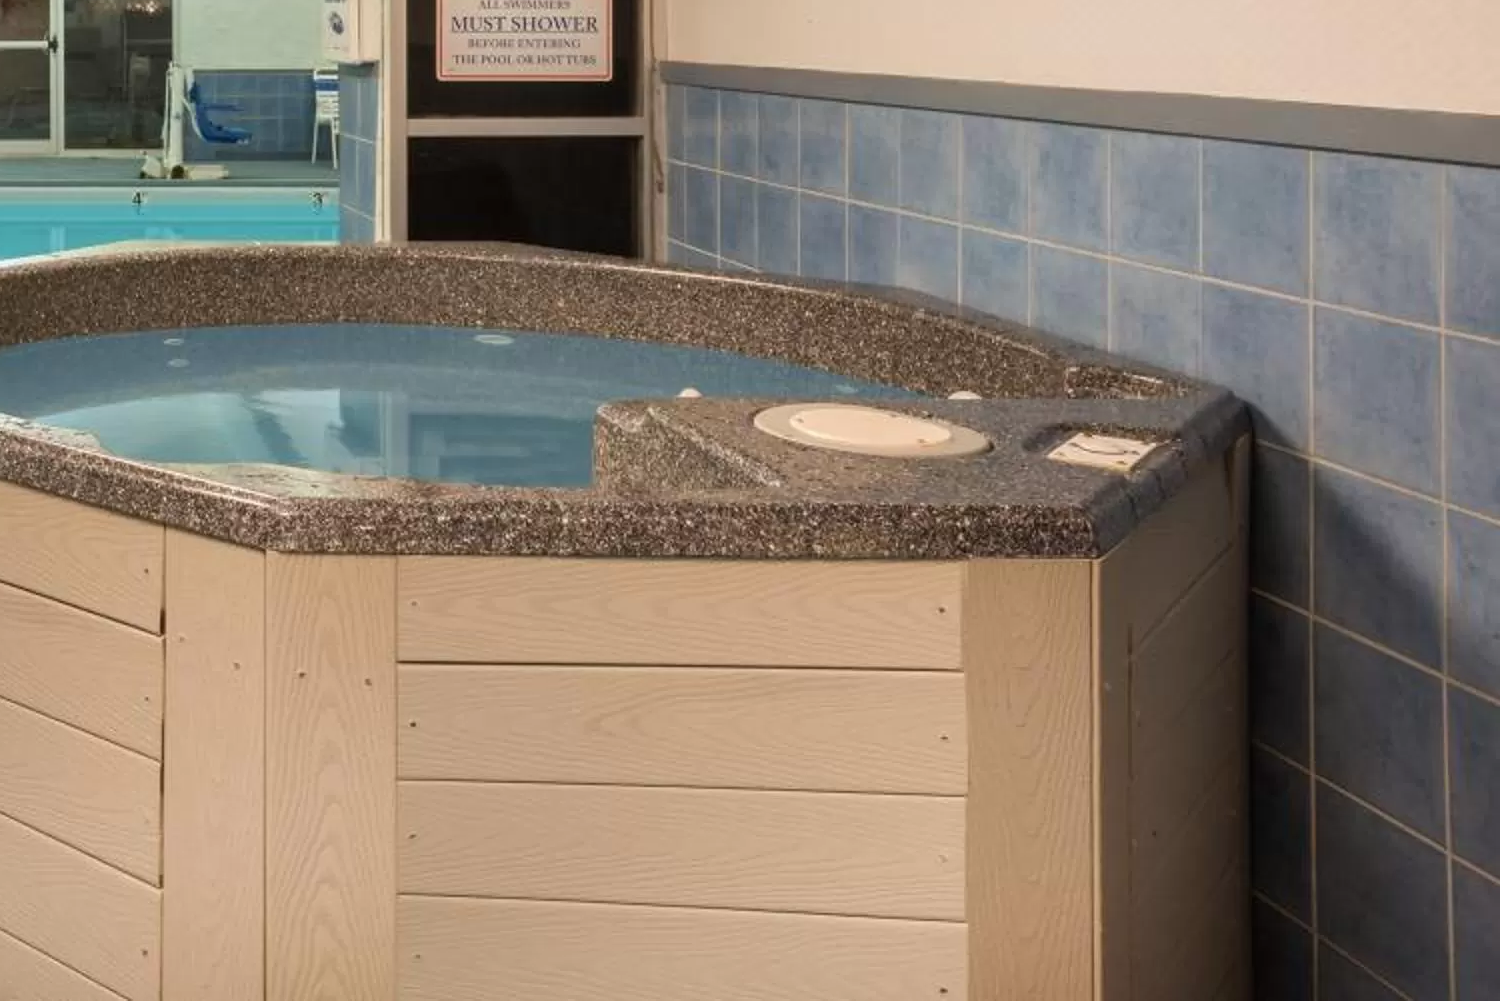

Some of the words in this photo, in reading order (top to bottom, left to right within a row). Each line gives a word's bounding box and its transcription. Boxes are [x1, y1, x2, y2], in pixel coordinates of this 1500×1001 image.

[478, 0, 501, 10] ALL
[503, 0, 571, 10] SWIMMERS
[451, 16, 507, 33] MUST
[510, 16, 598, 33] SHOWER
[467, 38, 514, 49] BEFORE
[517, 38, 581, 49] ENTERING
[452, 54, 478, 66] THE
[481, 54, 513, 66] POOL
[516, 54, 534, 66] OR
[537, 54, 563, 66] HOT
[565, 54, 597, 66] TUBS
